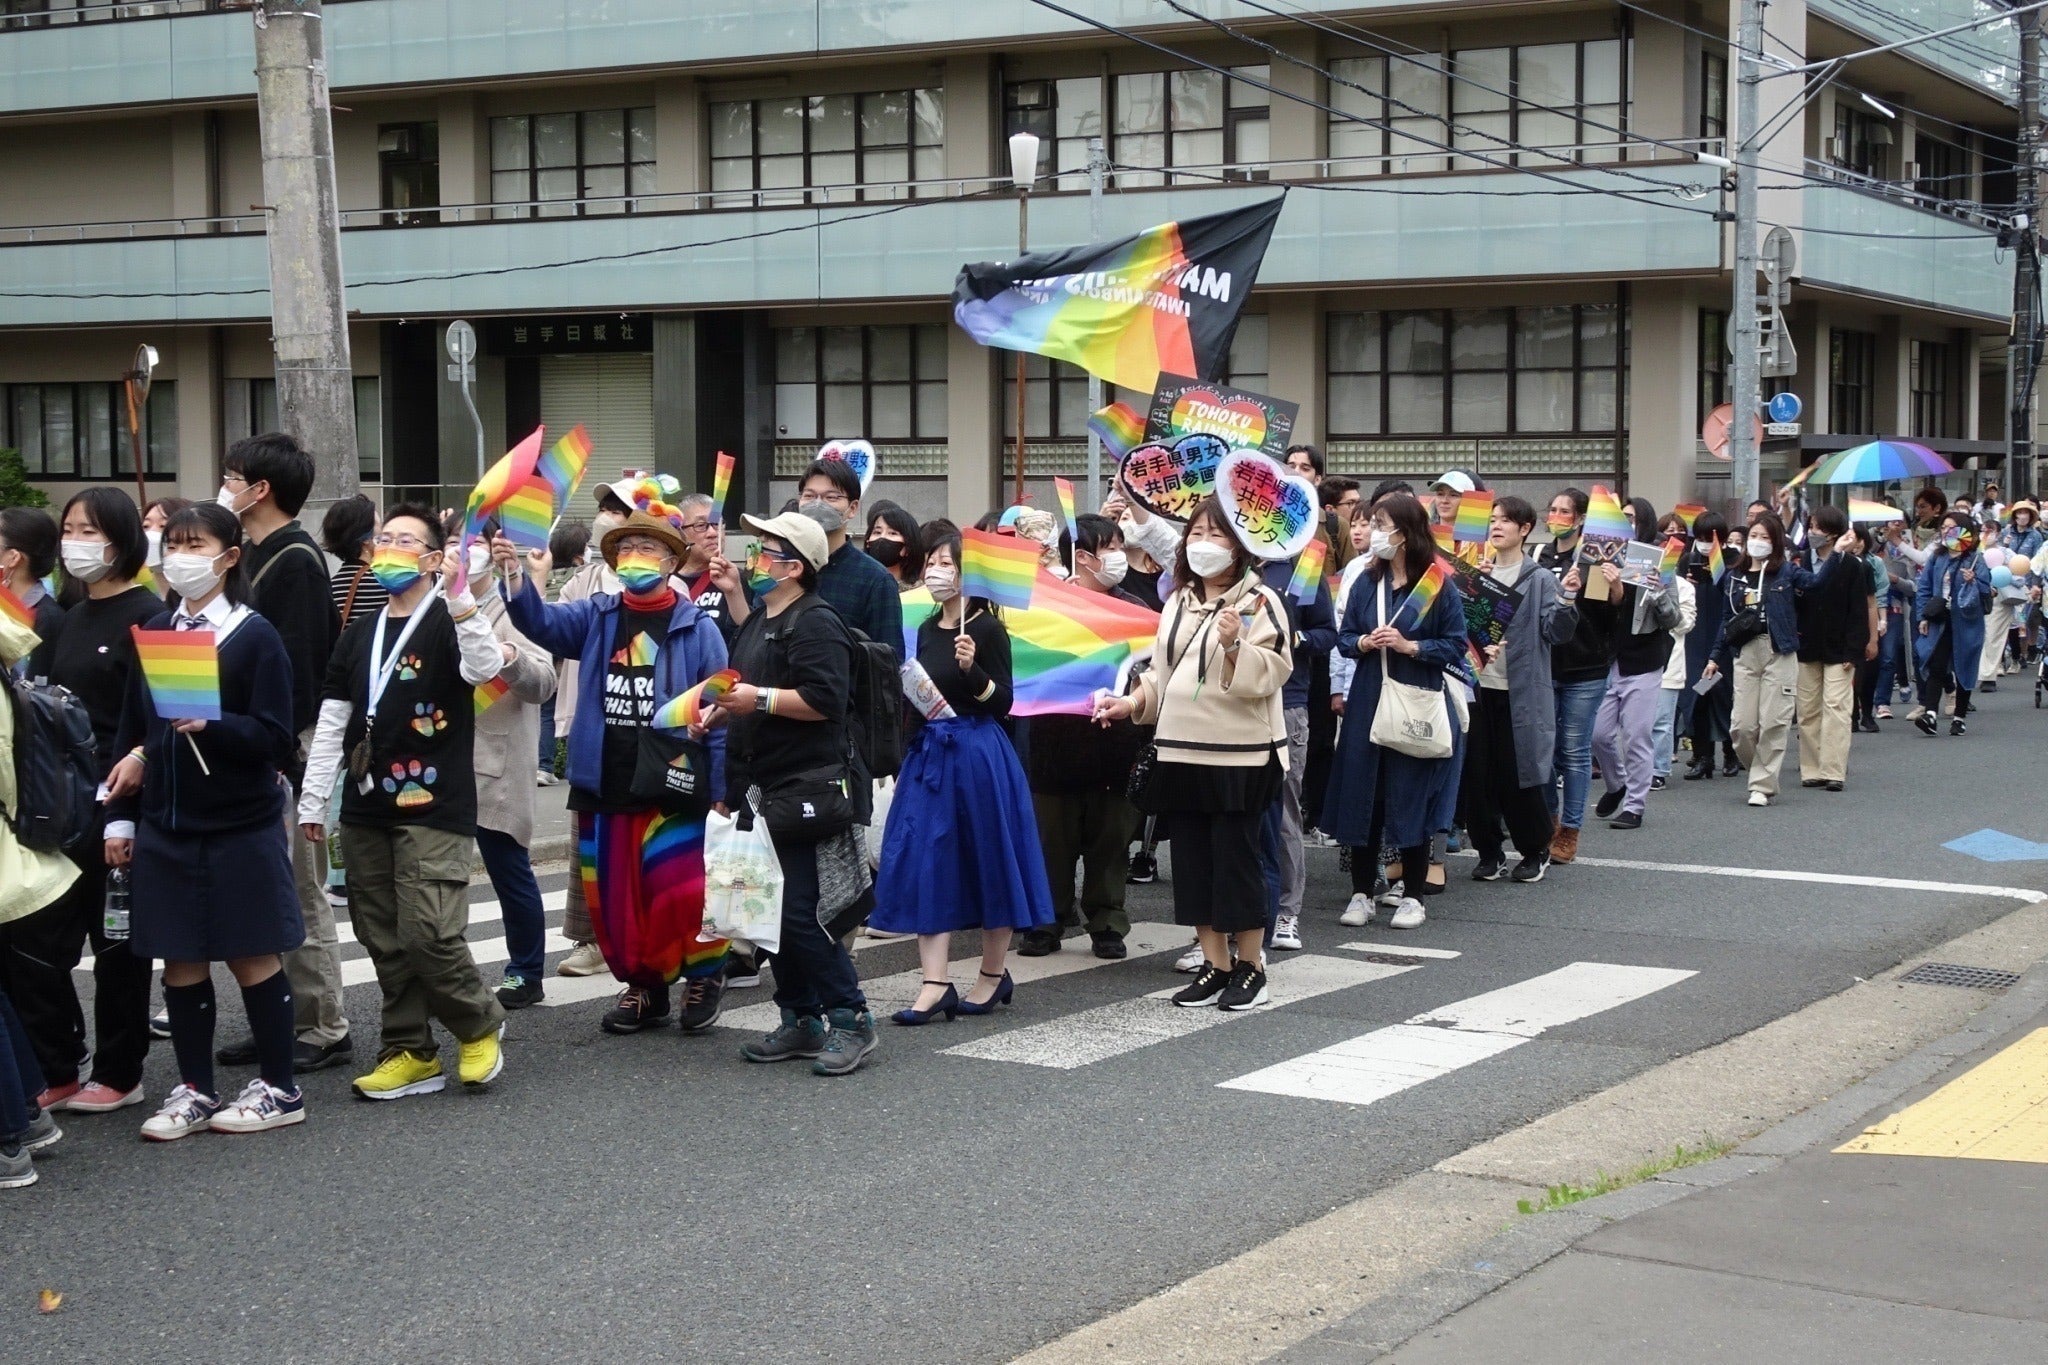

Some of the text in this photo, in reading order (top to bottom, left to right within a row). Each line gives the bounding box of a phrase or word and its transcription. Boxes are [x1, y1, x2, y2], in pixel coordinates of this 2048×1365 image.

[514, 324, 634, 343] 岩手日報社
[1188, 400, 1253, 429] TOHOKU
[1770, 425, 1797, 433] ここから
[1180, 417, 1253, 446] RAINBOW
[1130, 442, 1222, 478] 岩手県男女
[1145, 465, 1216, 498] 共同参画
[1234, 460, 1312, 523] 岩手県男女
[1237, 485, 1299, 539] 共同参画
[1233, 508, 1288, 551] センター
[667, 768, 695, 783] MARCH
